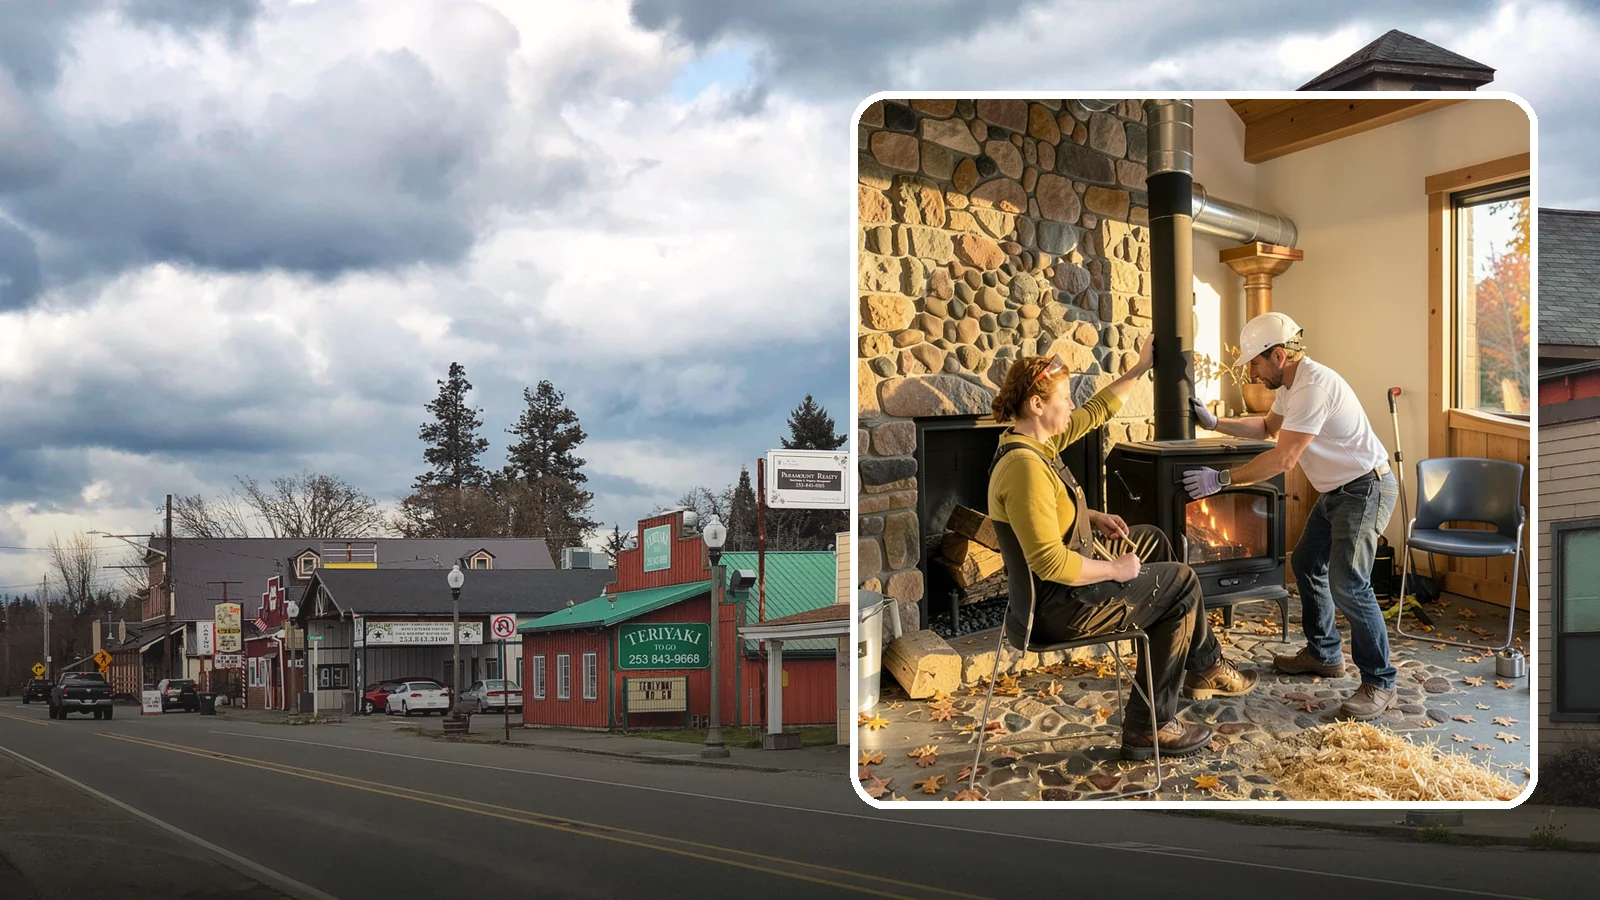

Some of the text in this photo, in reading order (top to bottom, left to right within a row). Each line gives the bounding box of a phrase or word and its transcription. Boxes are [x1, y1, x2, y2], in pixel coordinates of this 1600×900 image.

[781, 472, 815, 480] PARAMOUNT
[625, 627, 702, 646] TERIYAKI
[629, 653, 700, 665] 253 843-9668
